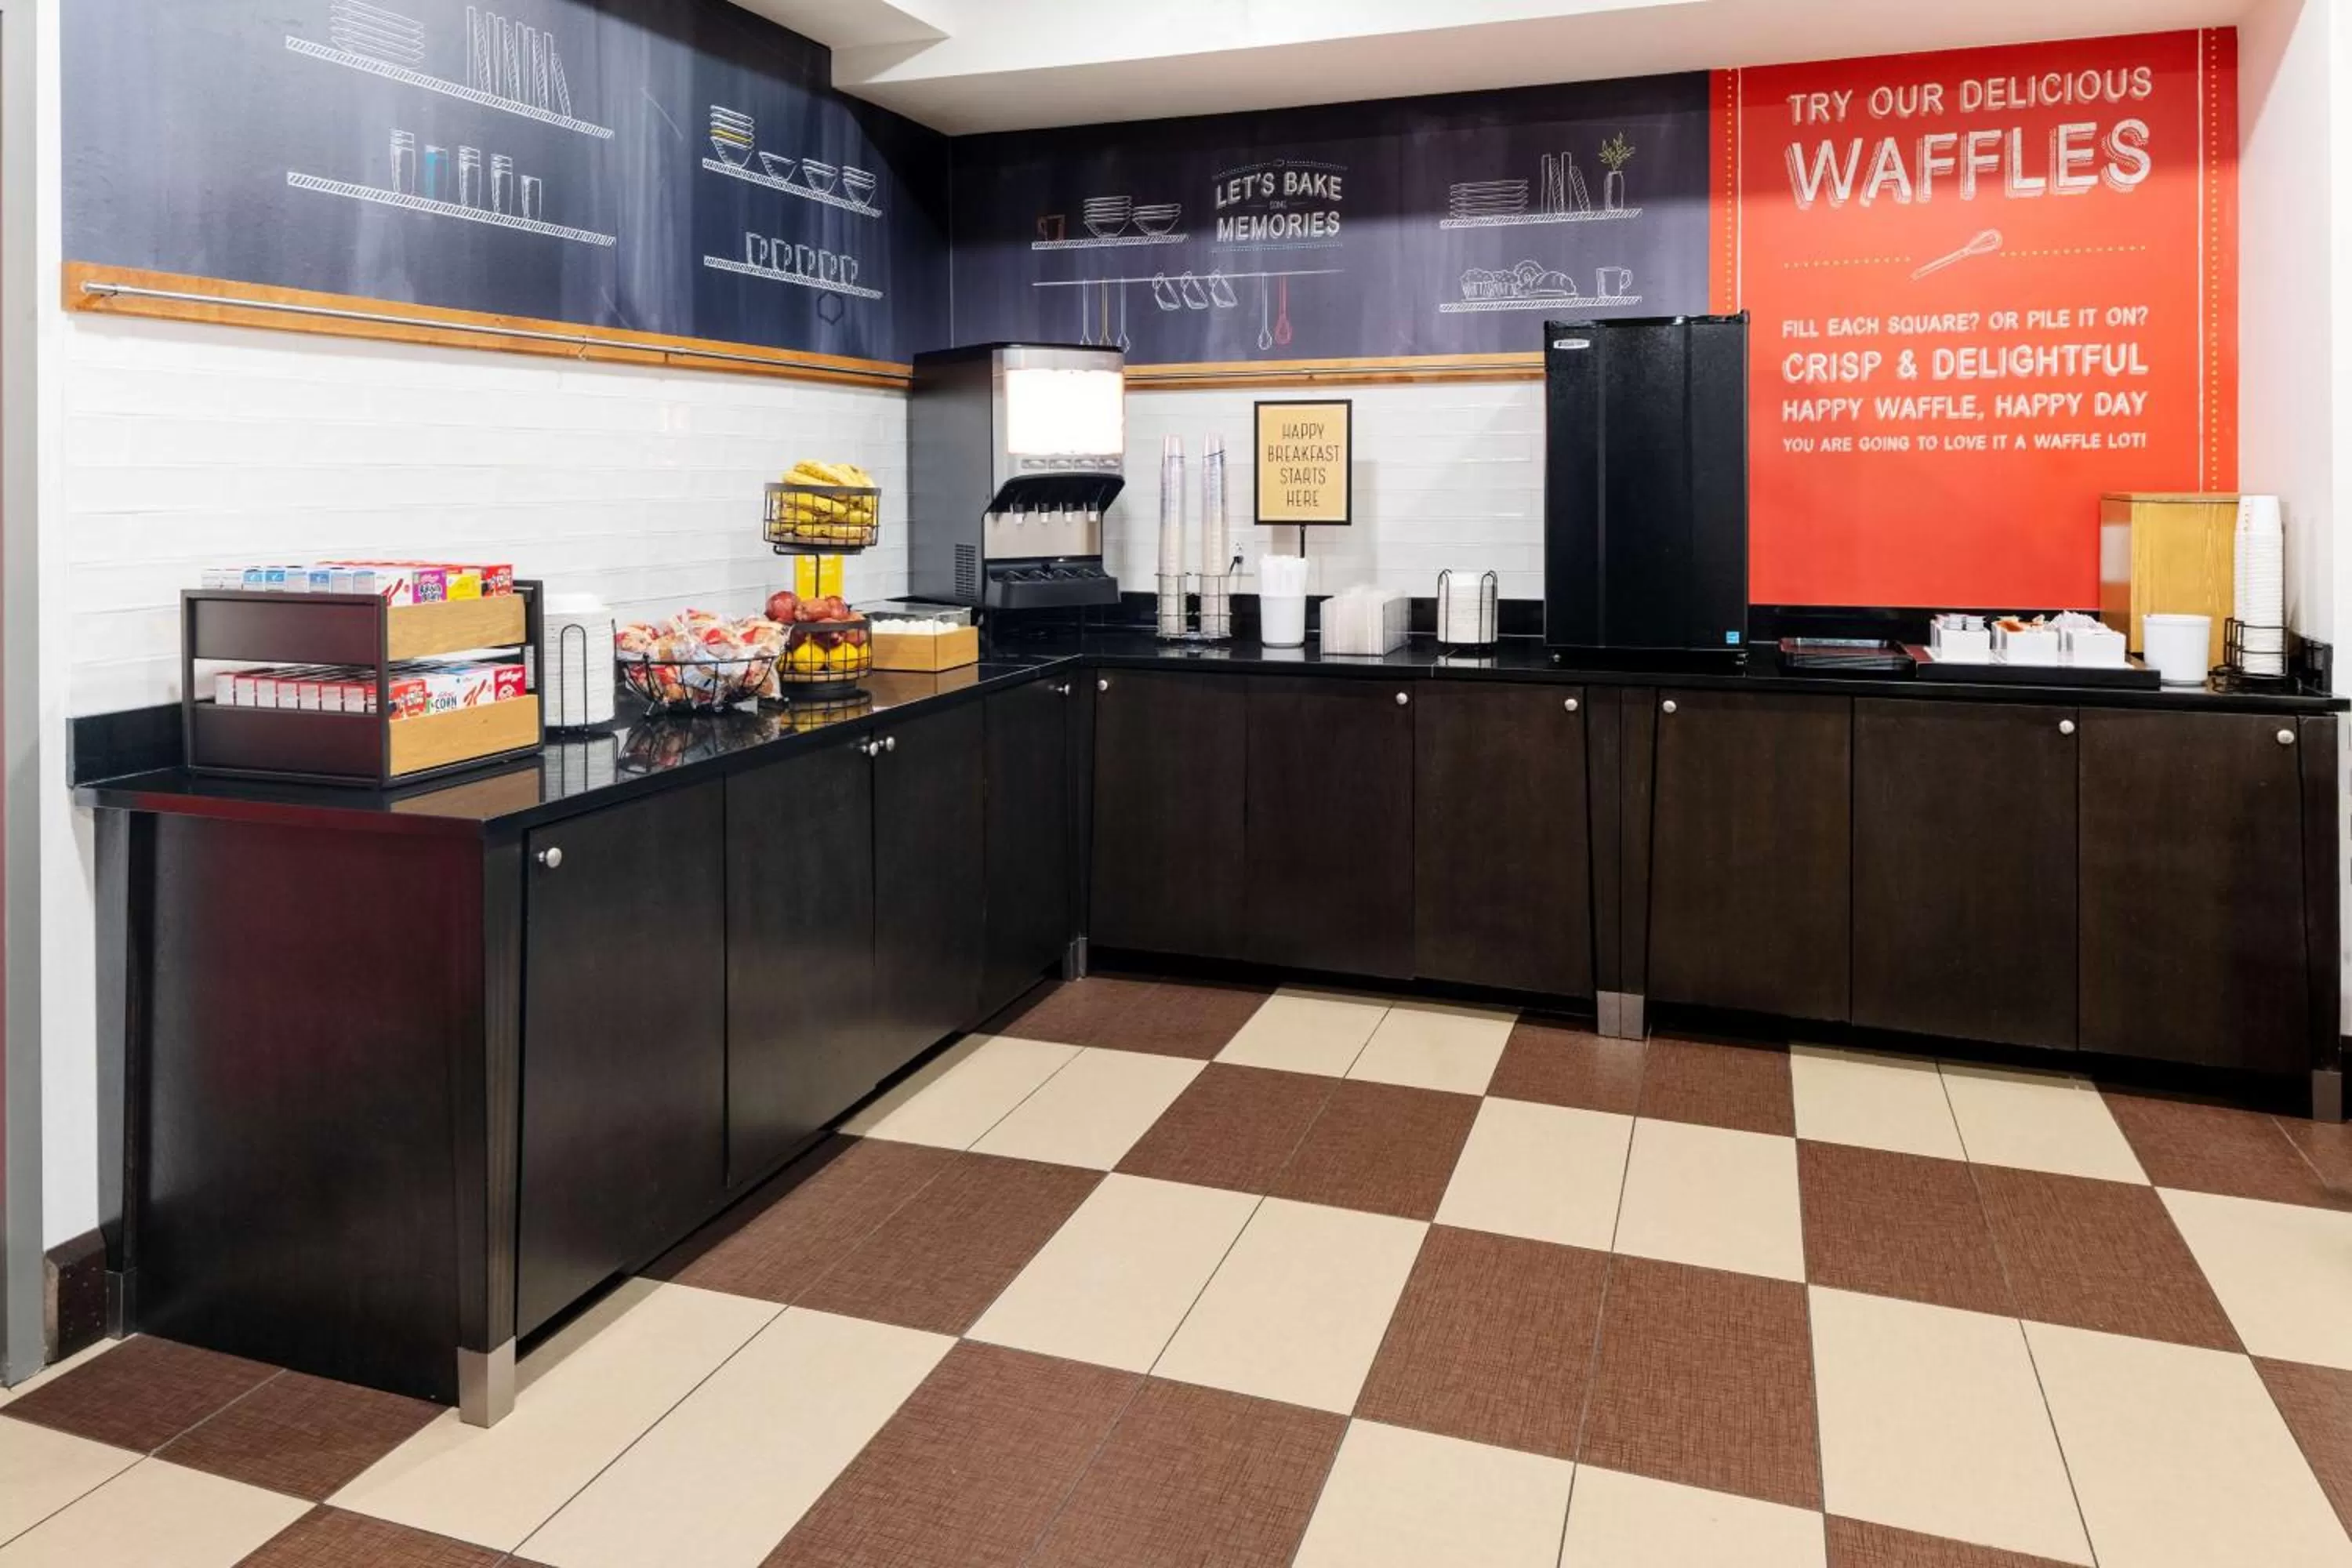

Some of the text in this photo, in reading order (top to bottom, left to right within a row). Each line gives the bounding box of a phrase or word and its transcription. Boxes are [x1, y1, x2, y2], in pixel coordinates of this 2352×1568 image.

[1786, 66, 2153, 124] TRY OUR DELICIOUS
[1785, 118, 2152, 209] WAFFLES
[1215, 171, 1343, 210] LET'S BAKE
[1215, 210, 1341, 242] MEMORIES
[1782, 307, 2149, 338] FILL EACH SQUARE? OR PILE IT ON?
[1782, 343, 2149, 383] CRISP & DELIGHTFUL
[1782, 391, 2148, 422] HAPPY WAFFLE, HAPPY DAY
[1282, 423, 1325, 440] HAPPY
[1783, 433, 2147, 452] YOU ARE GOING TO LOVE IT A WAFFLE LOT!
[1268, 445, 1339, 463] BREAKFAST
[1279, 467, 1326, 485] STARTS
[1287, 489, 1319, 506] HERE
